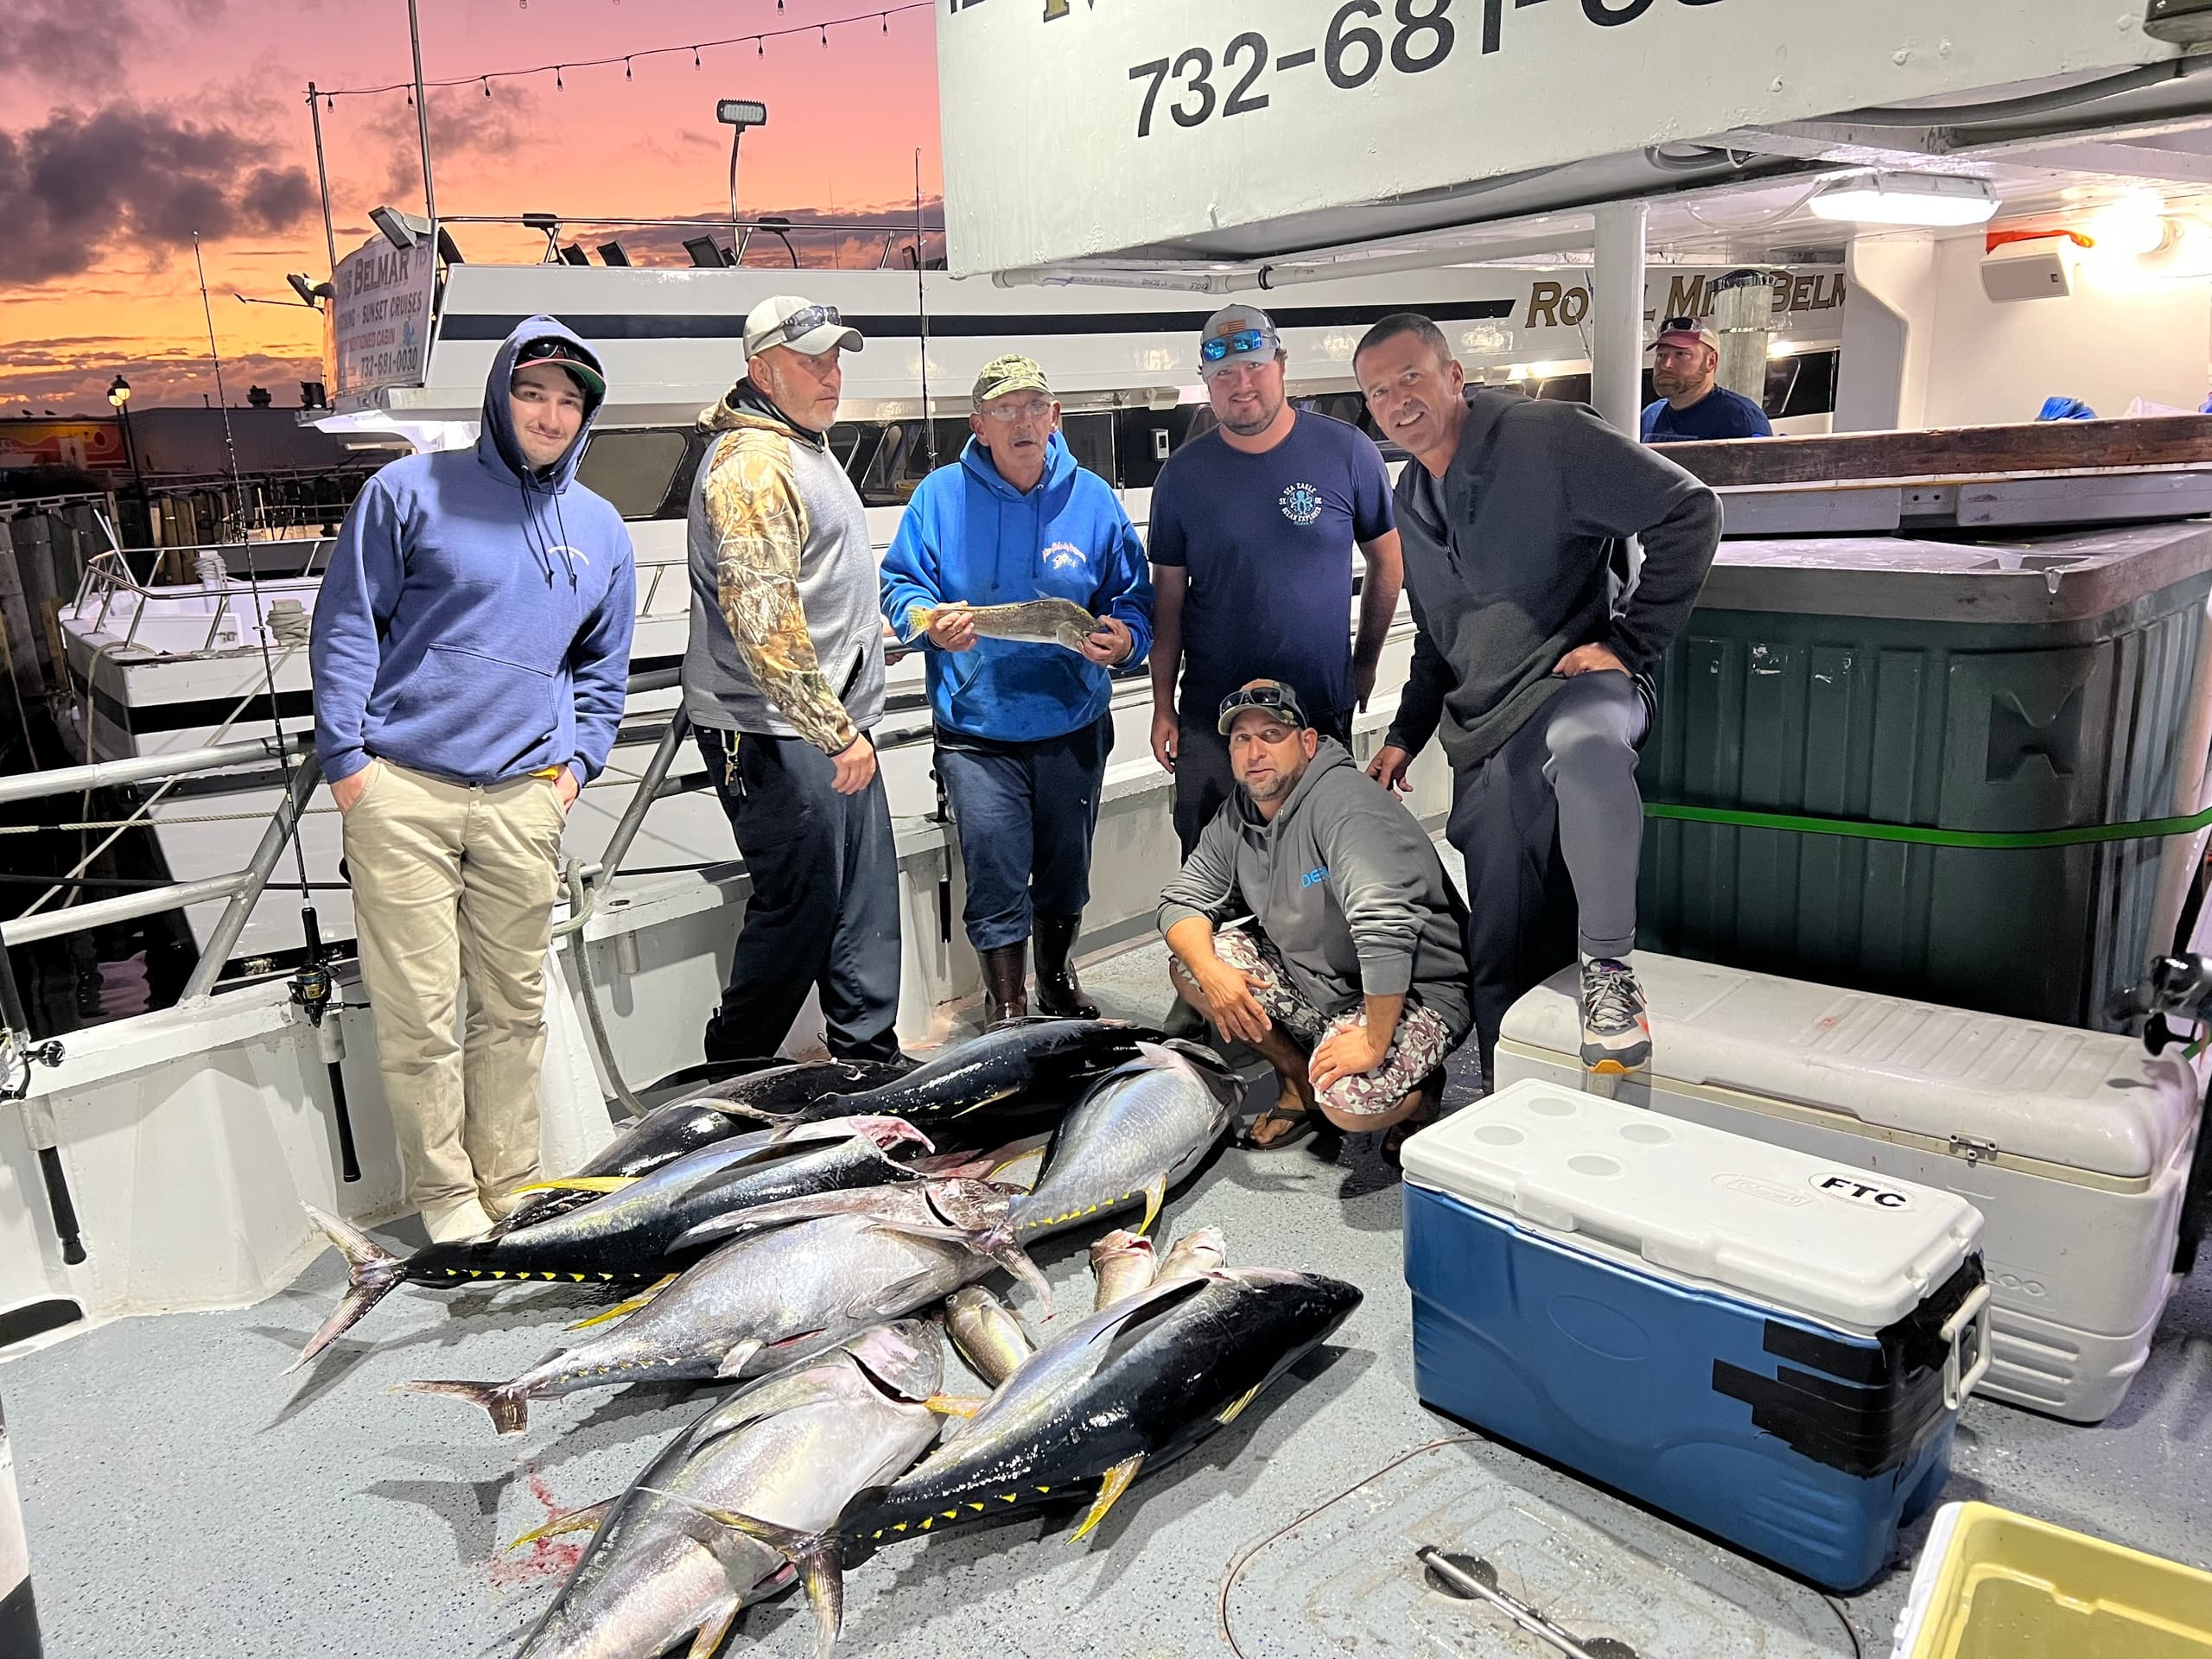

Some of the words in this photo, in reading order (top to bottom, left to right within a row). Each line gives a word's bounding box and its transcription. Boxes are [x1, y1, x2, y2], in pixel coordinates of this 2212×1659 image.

[354, 251, 409, 296] BELMAR
[1770, 271, 1846, 312] BELM
[363, 298, 388, 324] SUNSET
[391, 290, 422, 318] CRUISES
[1820, 1177, 1906, 1207] FTC
